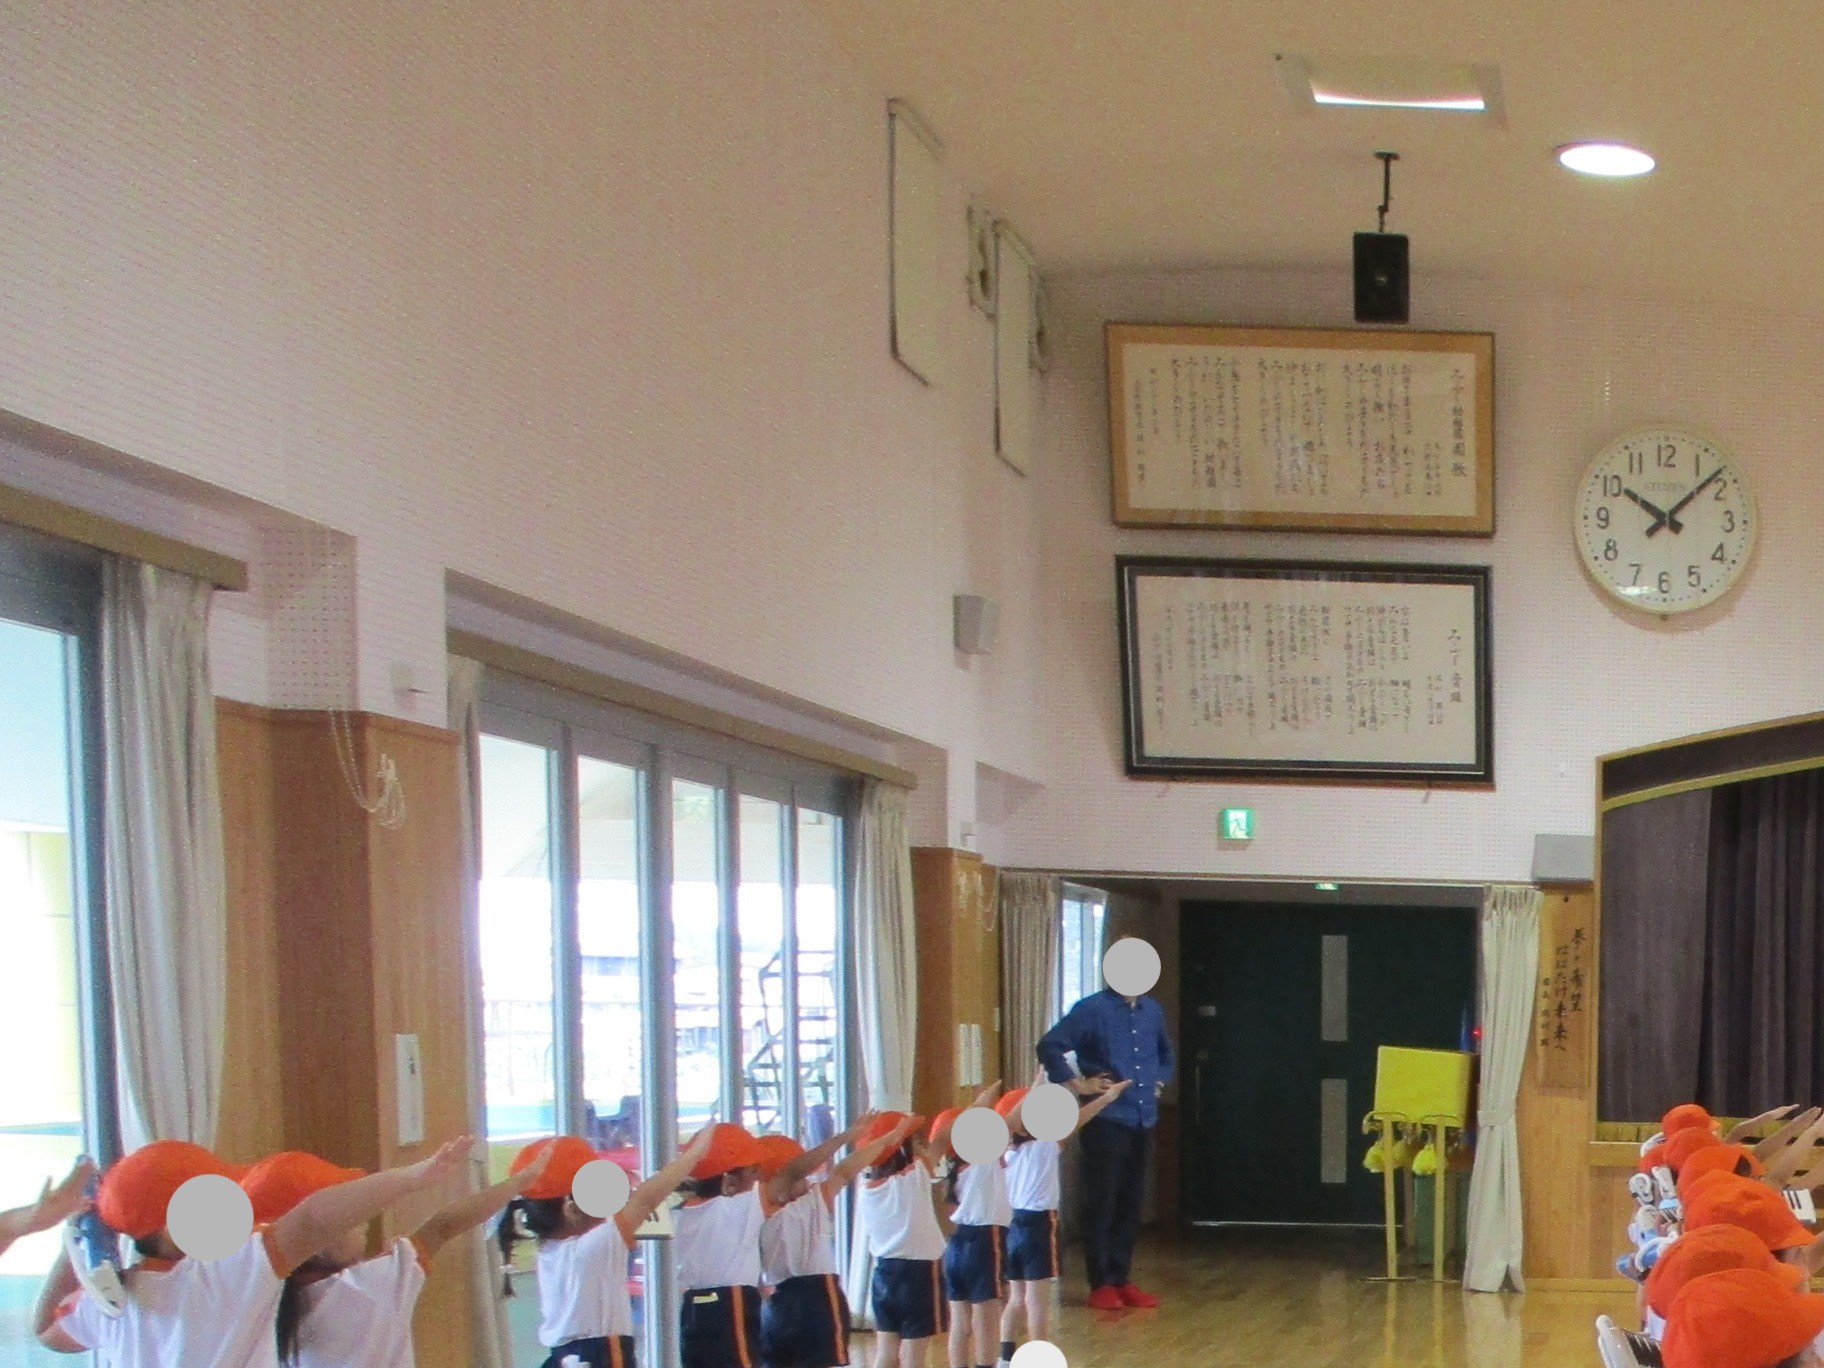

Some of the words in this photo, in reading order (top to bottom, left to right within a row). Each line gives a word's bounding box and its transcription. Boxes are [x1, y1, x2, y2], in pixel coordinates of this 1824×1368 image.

[1629, 452, 1644, 475] 11
[1657, 444, 1677, 468] 12
[1694, 454, 1700, 477] 1
[1603, 475, 1622, 497] 10
[1714, 477, 1727, 501] 2
[1596, 506, 1610, 529] 9
[1722, 510, 1735, 534] 3
[1604, 539, 1618, 561] 8
[1711, 542, 1726, 564] 4
[1629, 563, 1642, 586] 7
[1658, 571, 1671, 594] 6
[1687, 565, 1701, 587] 5
